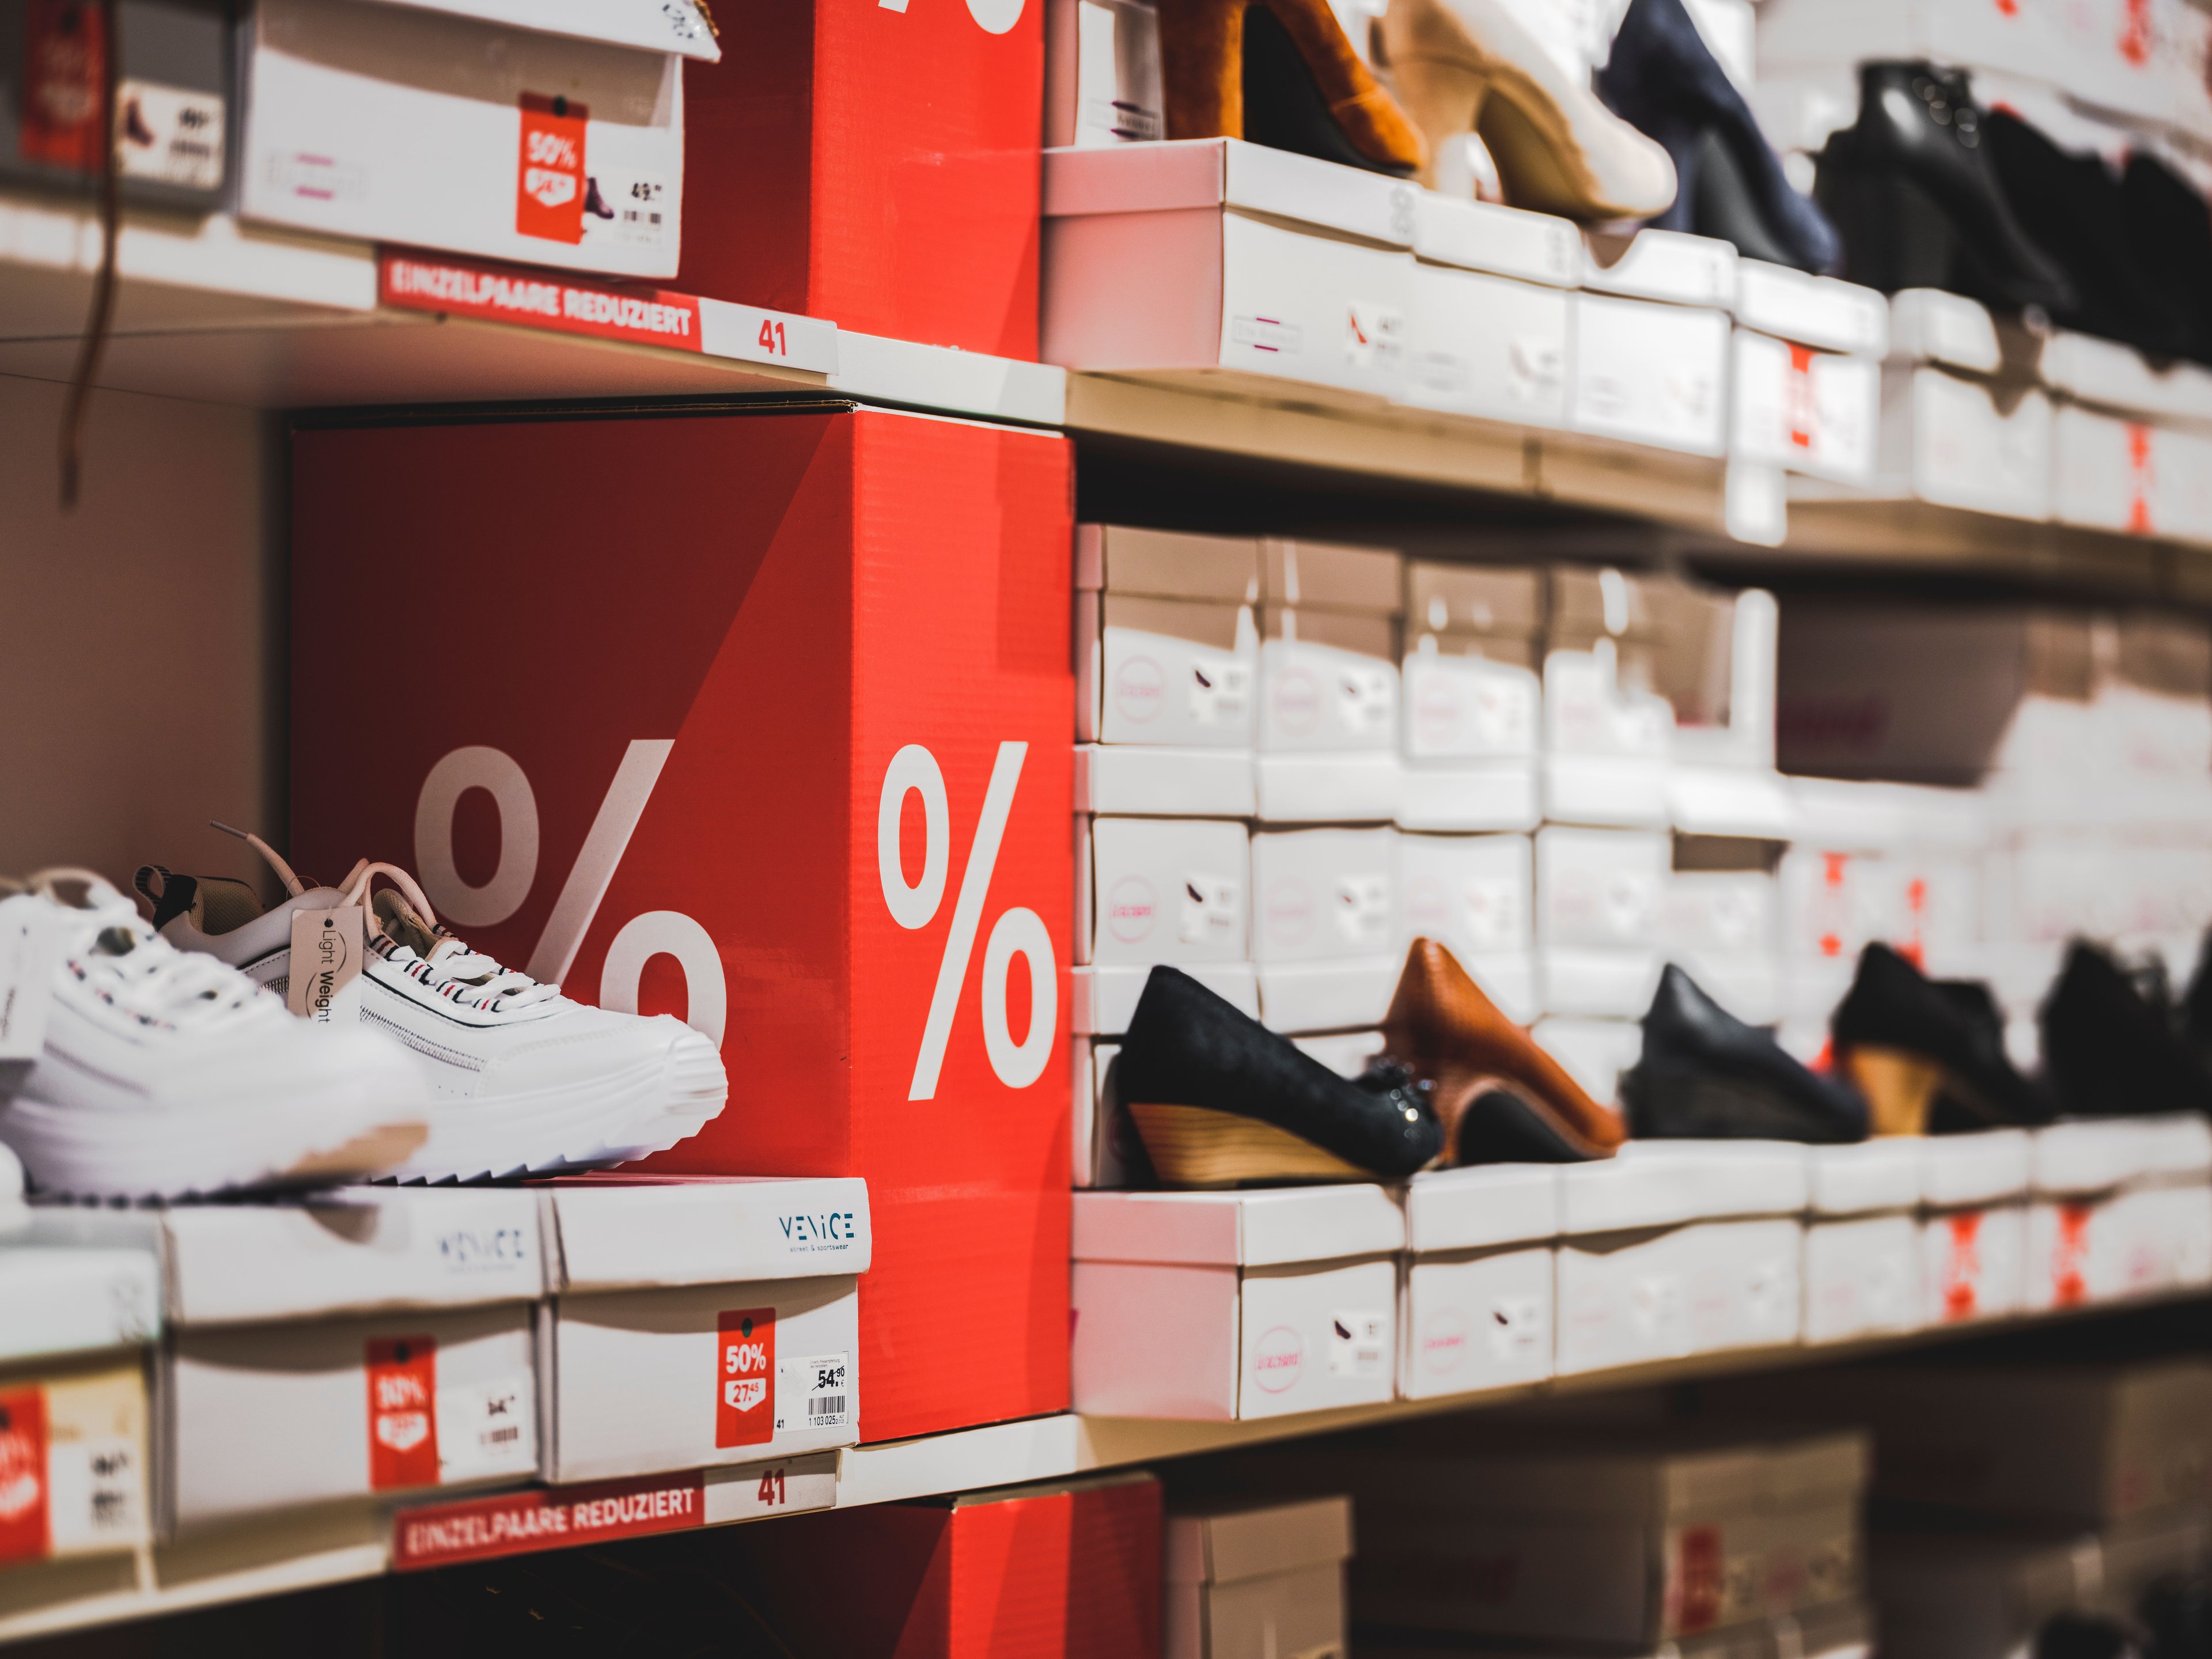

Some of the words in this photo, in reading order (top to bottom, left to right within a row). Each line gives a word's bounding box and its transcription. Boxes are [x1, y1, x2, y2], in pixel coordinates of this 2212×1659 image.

[563, 289, 691, 336] REDUZIERT
[759, 319, 786, 356] 41
[319, 930, 336, 964] Light
[878, 741, 1058, 1101] %
[315, 971, 335, 1024] Weight
[726, 1343, 766, 1374] 50%
[777, 1419, 784, 1429] 41
[574, 1488, 695, 1529] REDUZIERT
[758, 1468, 785, 1506] 41
